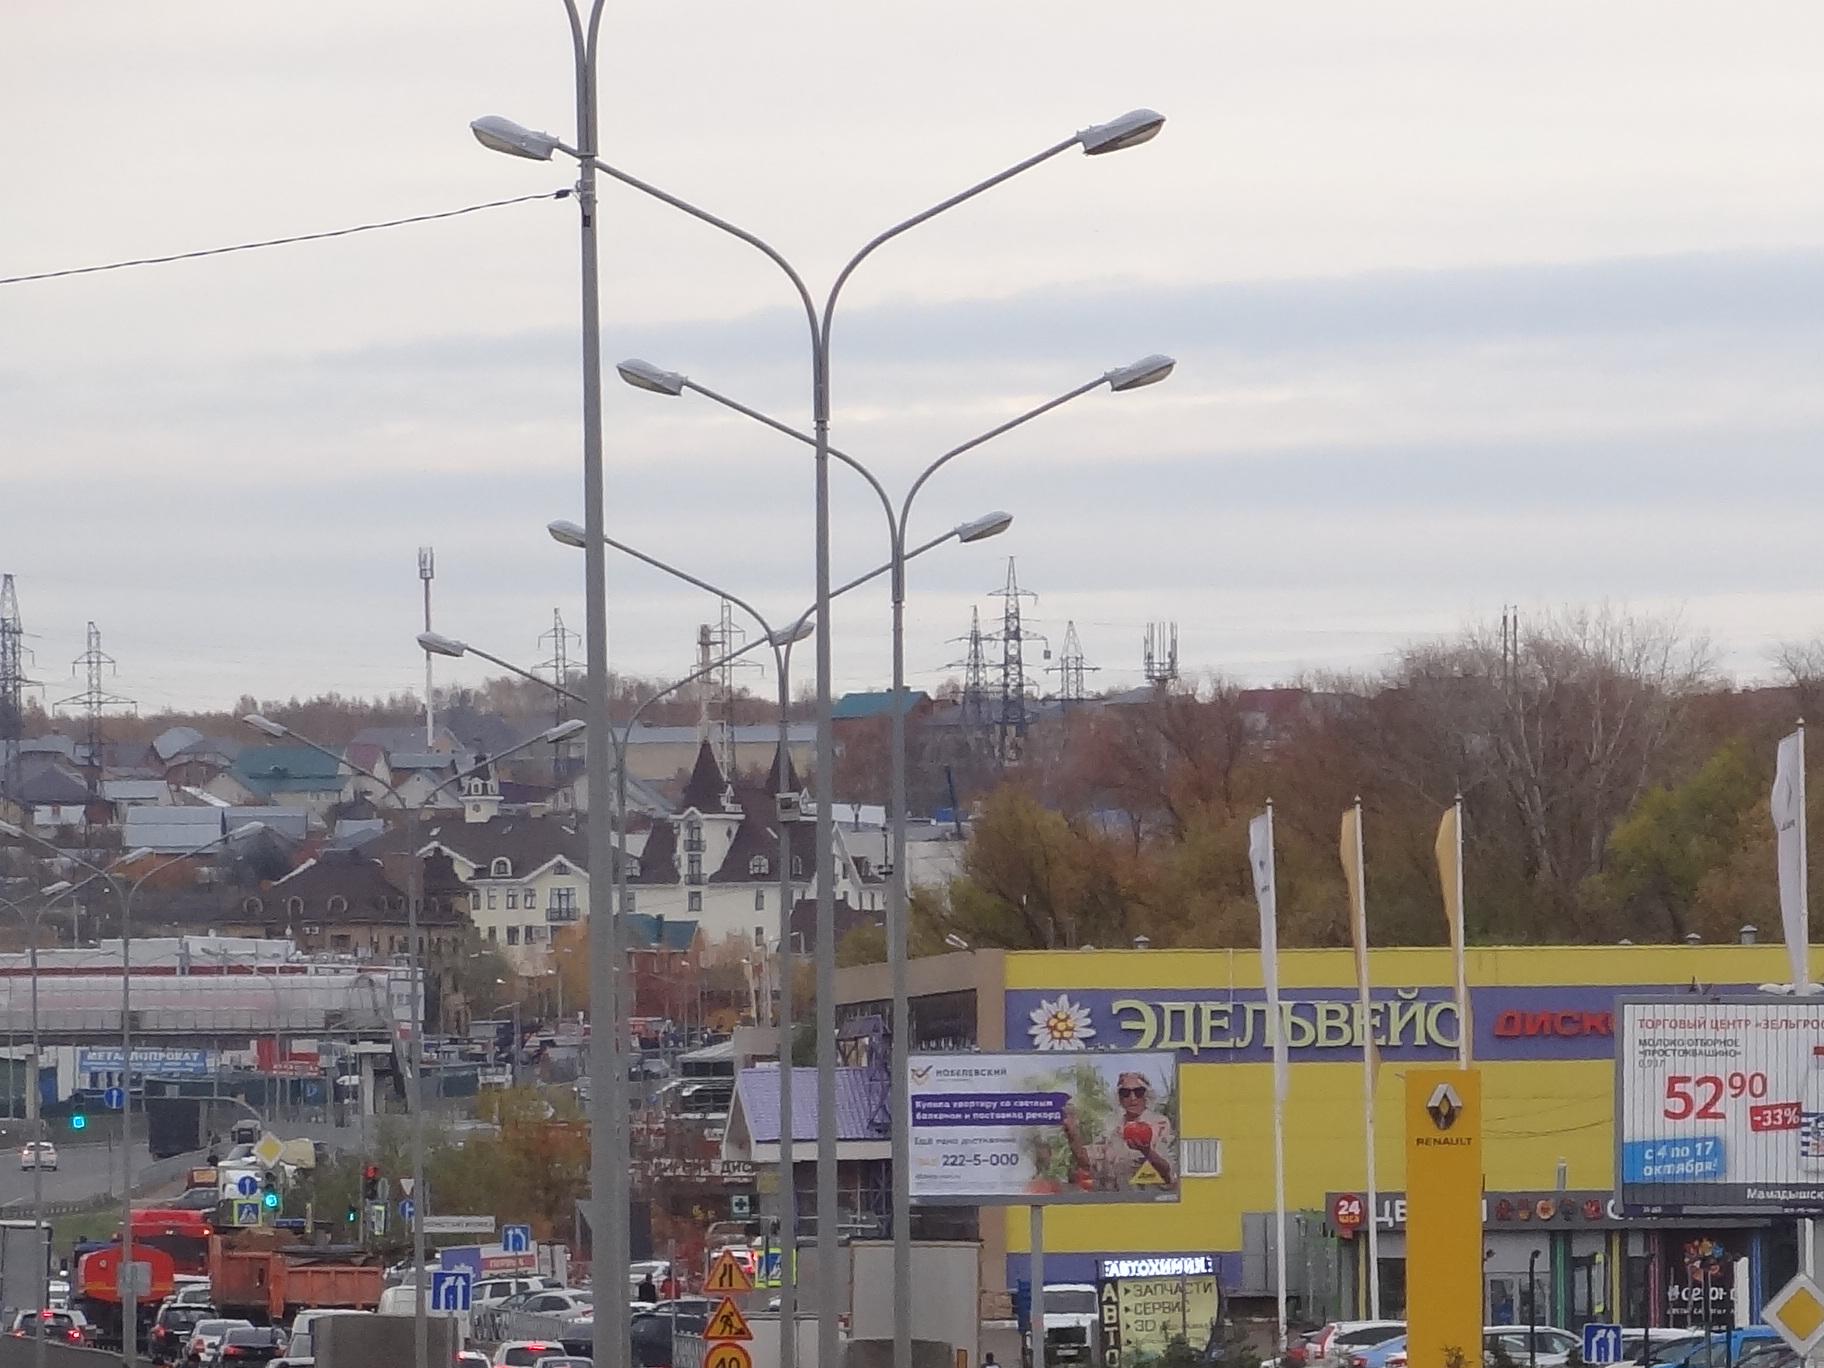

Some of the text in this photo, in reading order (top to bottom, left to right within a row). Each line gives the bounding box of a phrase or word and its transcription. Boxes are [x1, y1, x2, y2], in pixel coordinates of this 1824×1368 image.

[1111, 987, 1462, 1056] ЭДЕЛЬВЕЙС
[1637, 1017, 1707, 1030] ТОРГОВЫЙ
[1710, 1019, 1751, 1032] ЦЕНТР
[1752, 1107, 1800, 1127] -33%
[1416, 1137, 1473, 1147] RENAULT
[1657, 1144, 1667, 1158] 4
[1671, 1146, 1690, 1158] по
[1695, 1141, 1715, 1156] 17
[942, 1153, 1020, 1167] 222-5-000
[1338, 1199, 1361, 1215] 24
[1133, 1281, 1214, 1298] ЗАПЧАСТИ
[1134, 1299, 1191, 1316] СЕРВИС
[1101, 1282, 1121, 1368] АВТО
